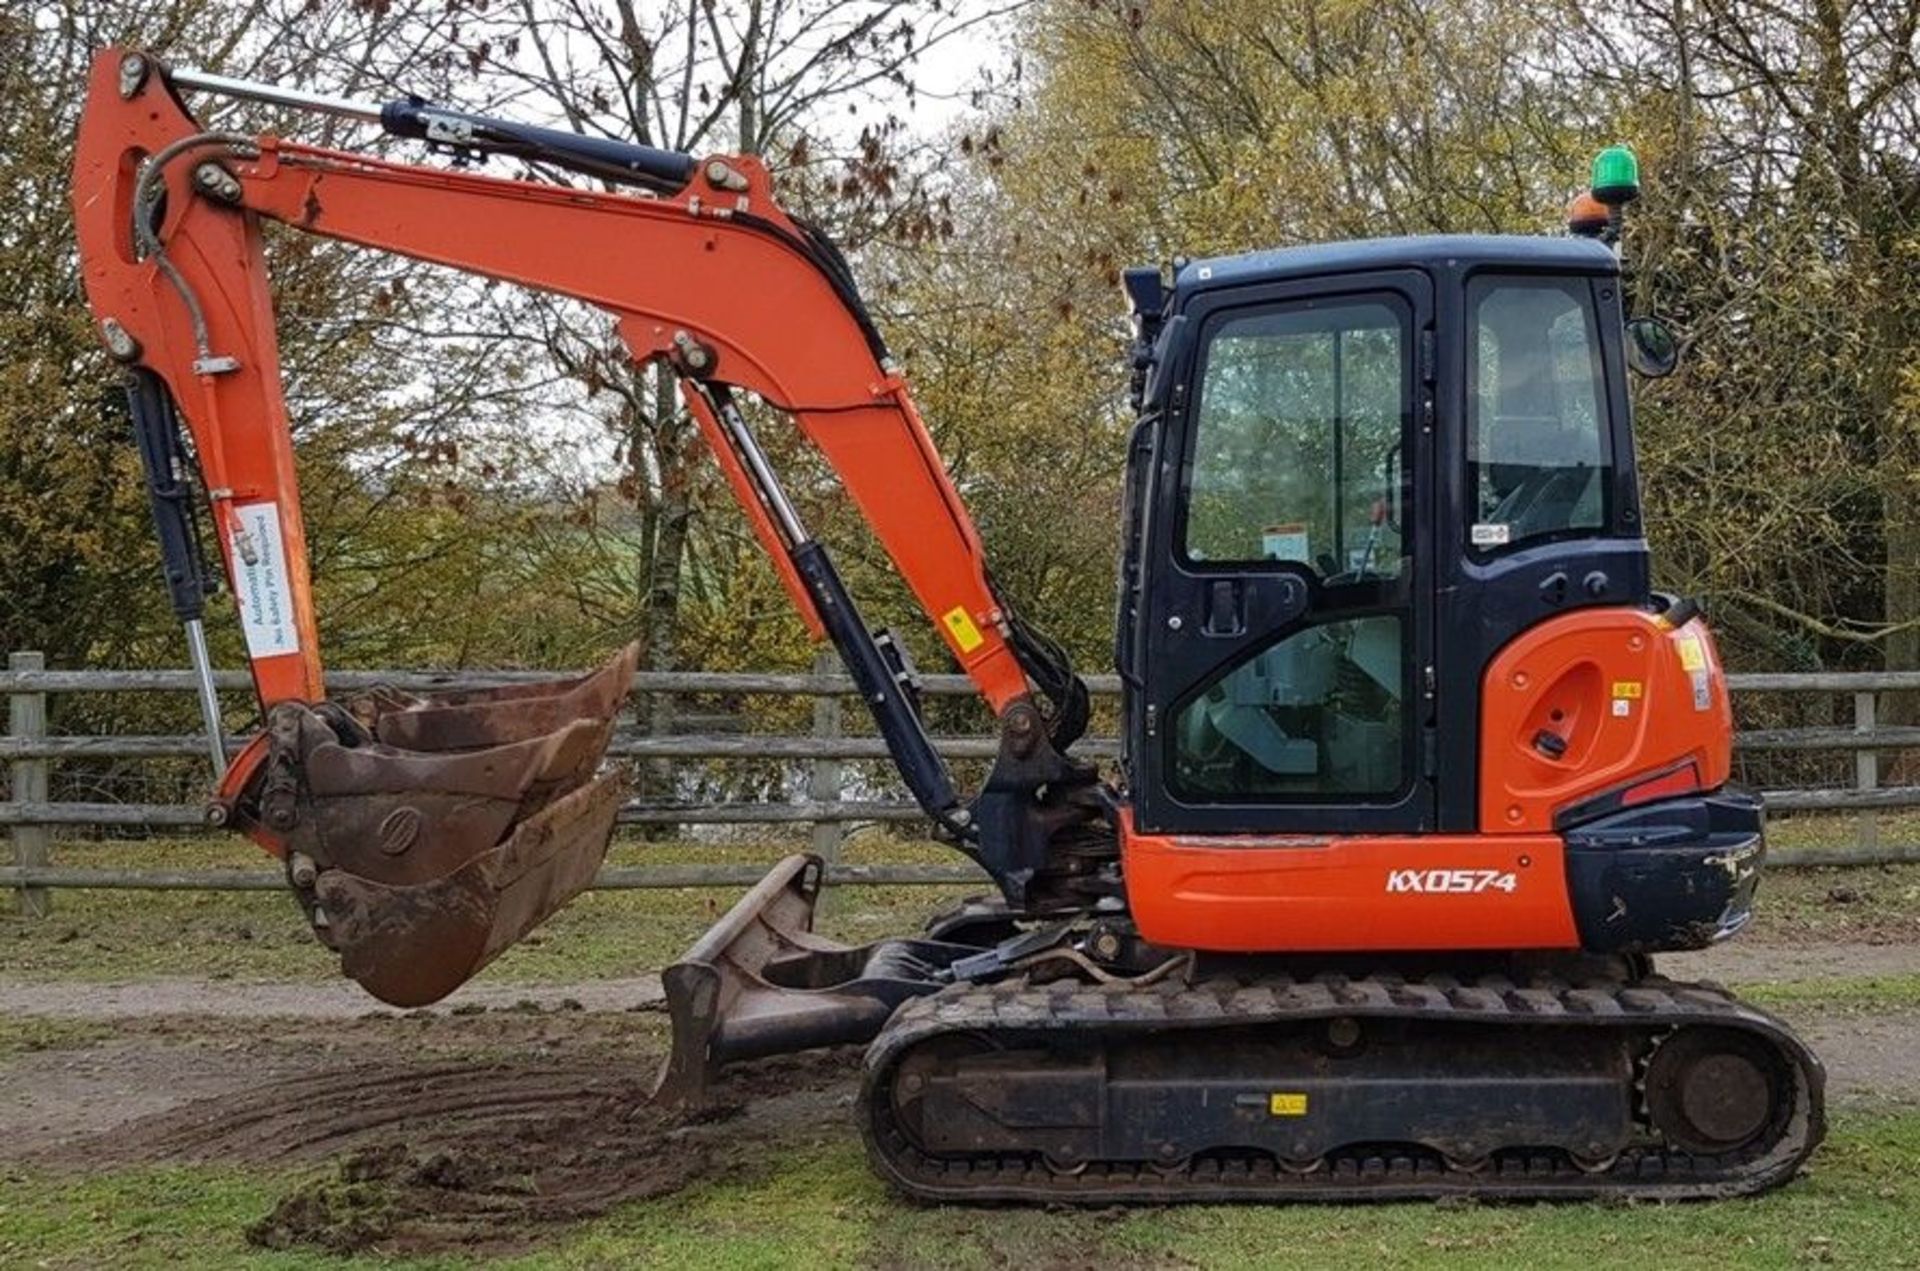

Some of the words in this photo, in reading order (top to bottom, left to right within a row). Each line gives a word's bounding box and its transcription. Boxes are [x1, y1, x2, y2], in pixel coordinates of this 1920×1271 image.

[256, 514, 271, 567] Required
[265, 569, 275, 588] Pin
[269, 590, 282, 625] Safety
